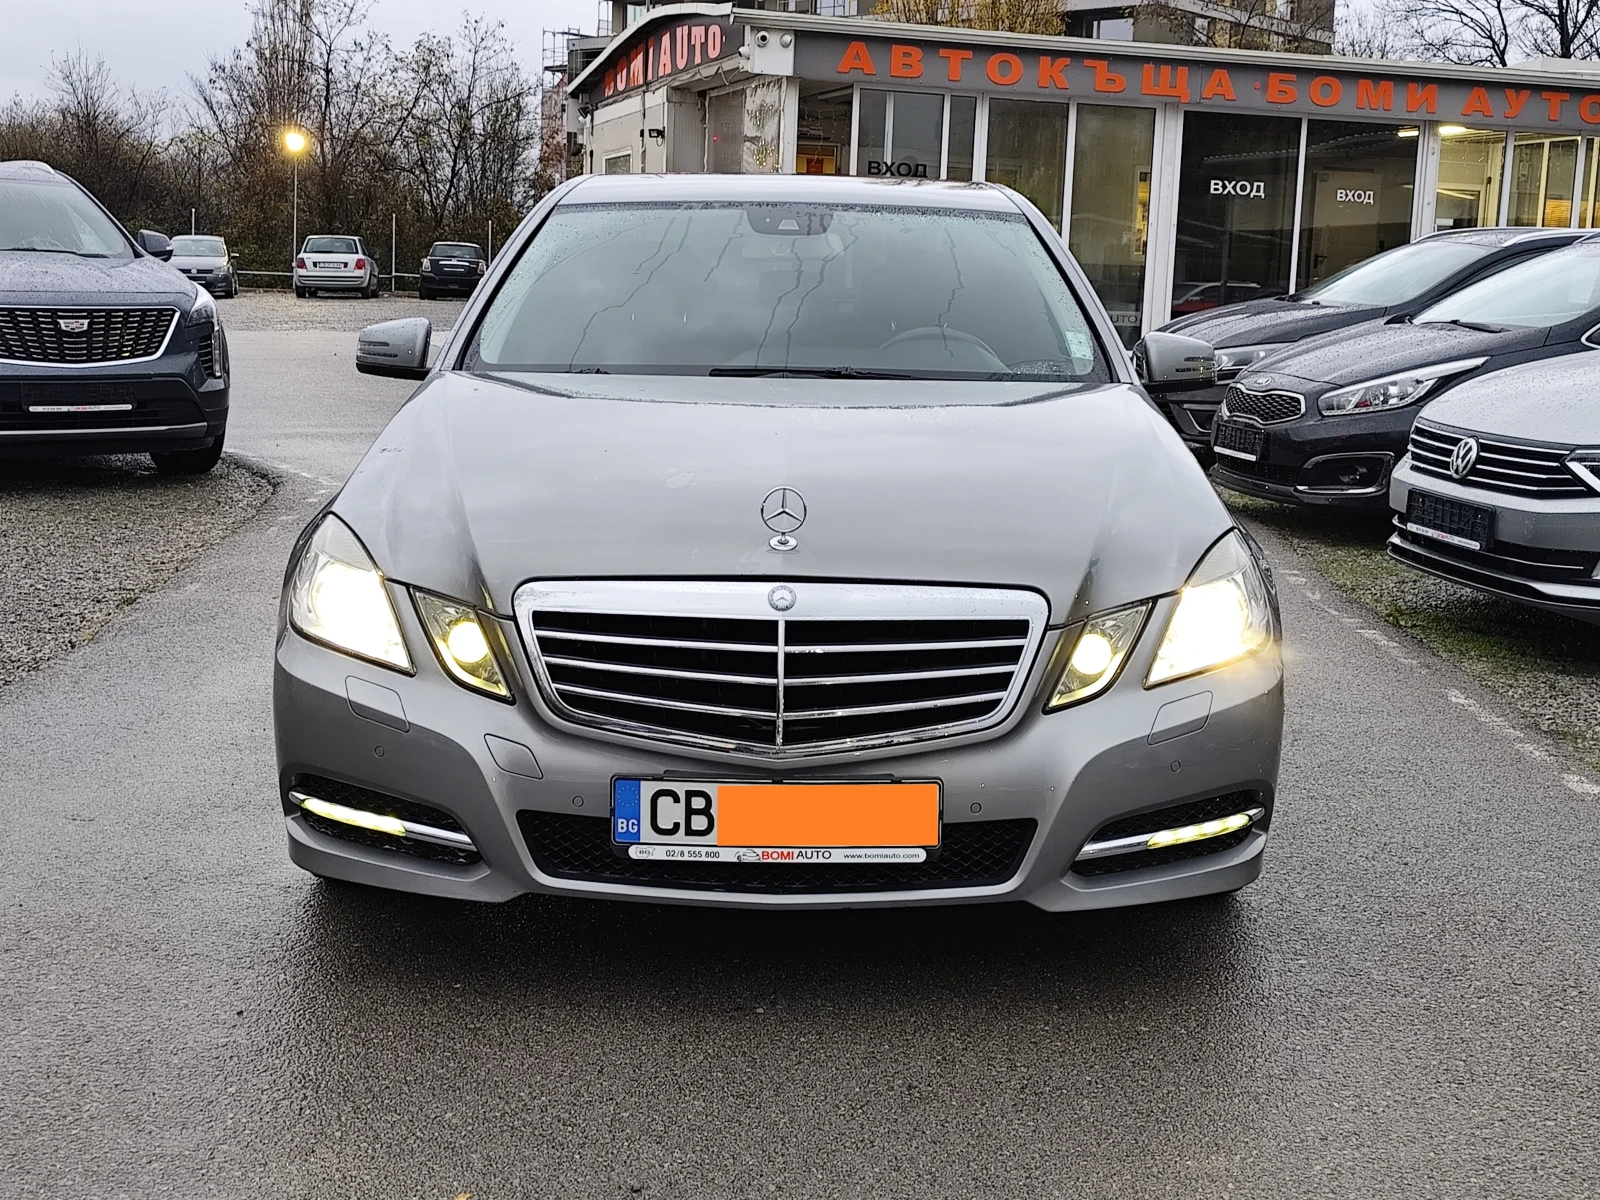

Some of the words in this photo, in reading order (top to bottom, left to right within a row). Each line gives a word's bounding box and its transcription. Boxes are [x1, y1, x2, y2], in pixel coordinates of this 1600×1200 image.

[837, 41, 1236, 104] АВТОКЪЩА
[1266, 72, 1439, 114] БОМИ
[1461, 86, 1600, 125] АУТО
[867, 160, 928, 178] ВХОД
[1210, 179, 1265, 199] ВХОД
[1336, 189, 1374, 205] ВХОД
[1110, 314, 1138, 324] UTO
[650, 788, 715, 837] CB
[617, 818, 639, 833] BG
[665, 849, 685, 858] 02/8
[687, 850, 703, 858] 555
[704, 850, 720, 859] 800
[761, 850, 795, 861] BOMI
[796, 850, 832, 860] AUTO
